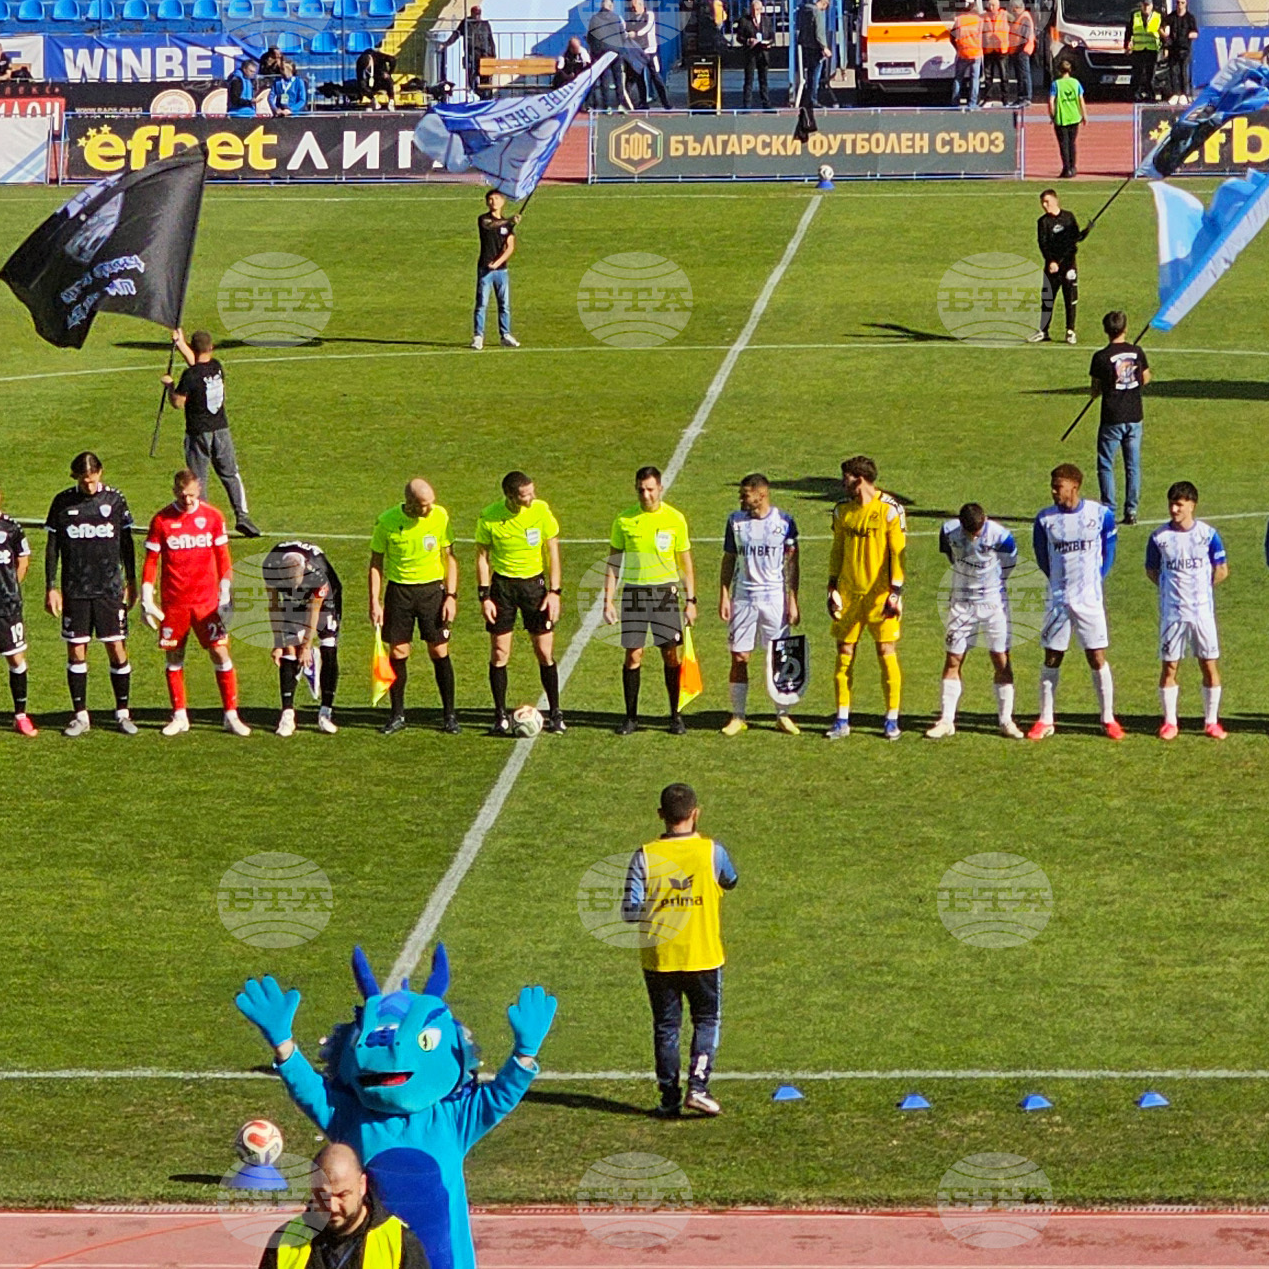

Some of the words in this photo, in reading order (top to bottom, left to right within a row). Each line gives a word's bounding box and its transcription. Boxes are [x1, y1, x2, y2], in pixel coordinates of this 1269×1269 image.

[286, 130, 444, 170] ЛИГ
[619, 131, 652, 161] БФС
[669, 133, 802, 157] БЪЛГАРСКИ
[807, 131, 929, 157] ФУТБОЛЕН
[936, 131, 1005, 154] СЪЮЗ
[66, 521, 115, 539] efbet
[166, 532, 213, 550] efbet
[10, 622, 24, 644] 19
[660, 891, 704, 909] erima
